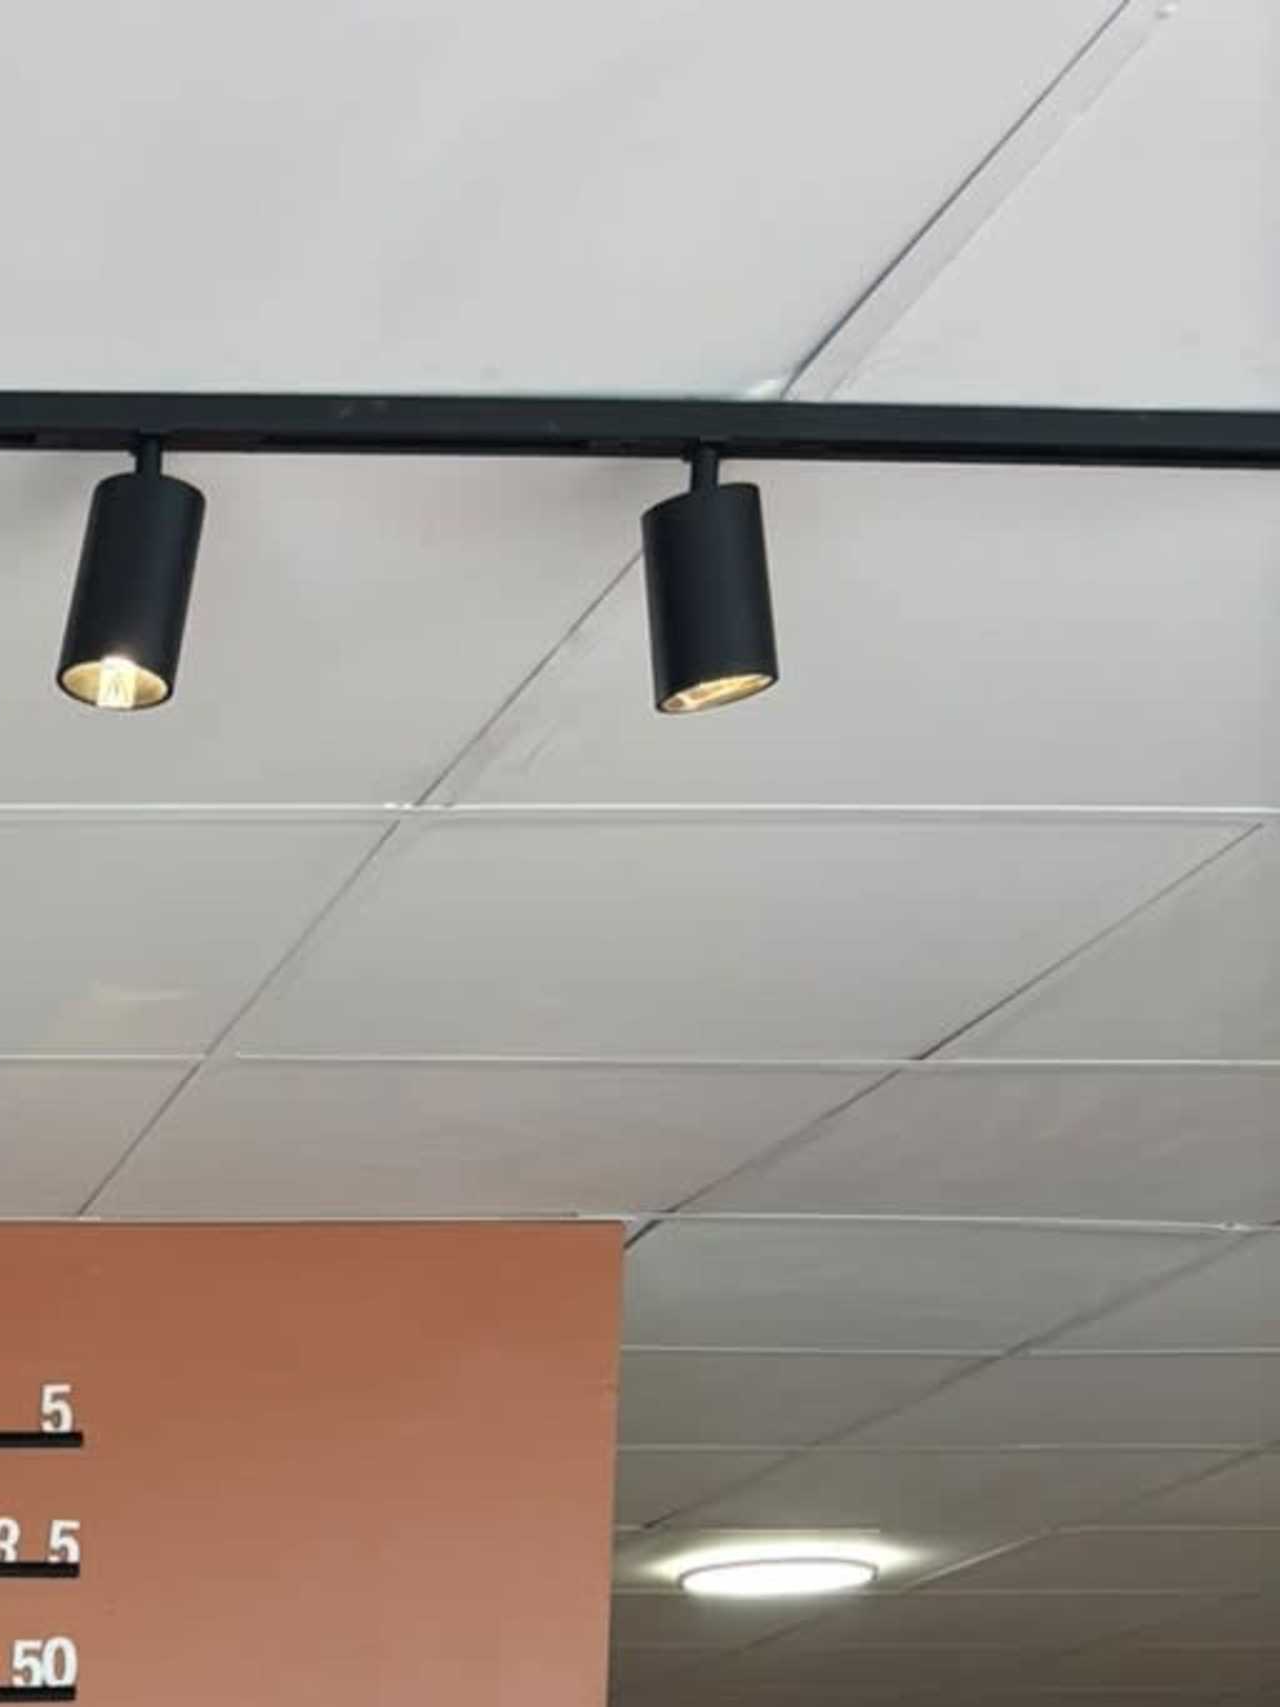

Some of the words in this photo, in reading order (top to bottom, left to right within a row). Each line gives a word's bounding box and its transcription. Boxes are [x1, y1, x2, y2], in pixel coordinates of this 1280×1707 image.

[41, 1384, 73, 1433] 5
[47, 1520, 80, 1563] 5
[11, 1636, 77, 1687] 50
